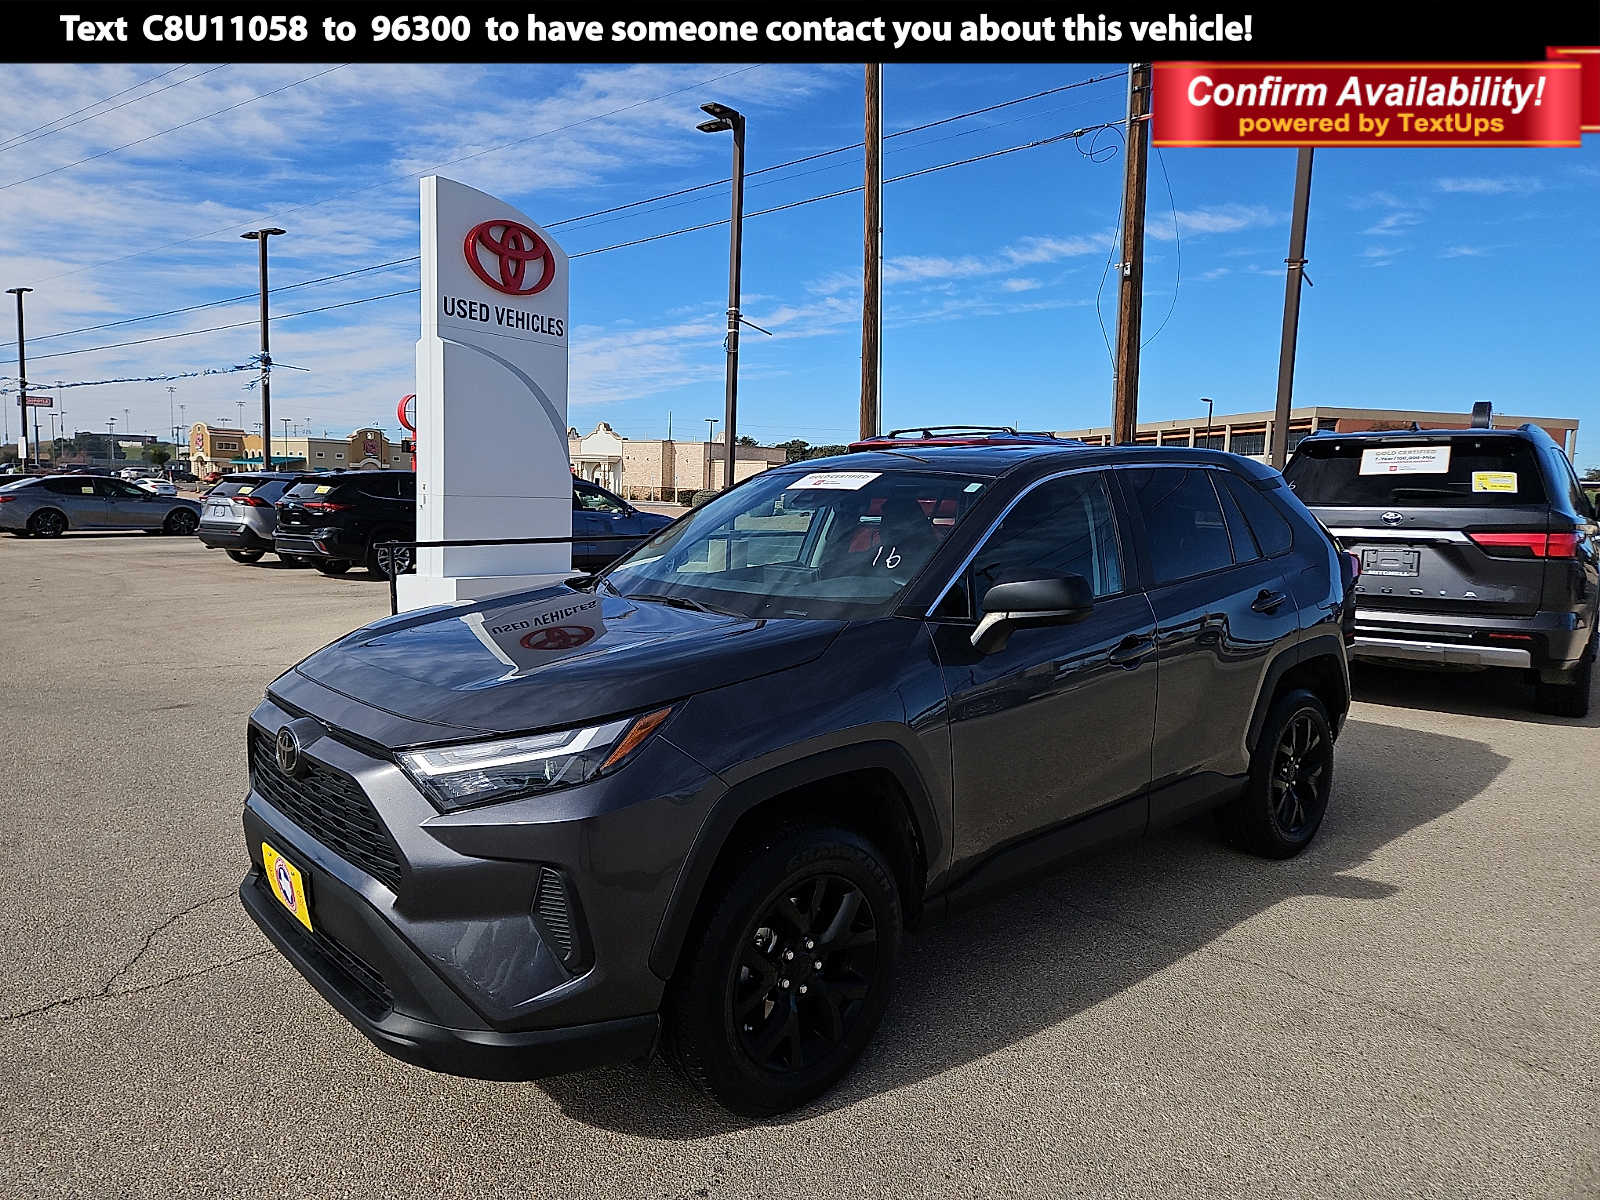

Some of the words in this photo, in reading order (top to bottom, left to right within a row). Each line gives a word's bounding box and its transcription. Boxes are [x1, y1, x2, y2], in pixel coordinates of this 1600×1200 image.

[443, 296, 490, 323] USED
[495, 305, 564, 337] VEHICLES
[872, 546, 901, 569] 16
